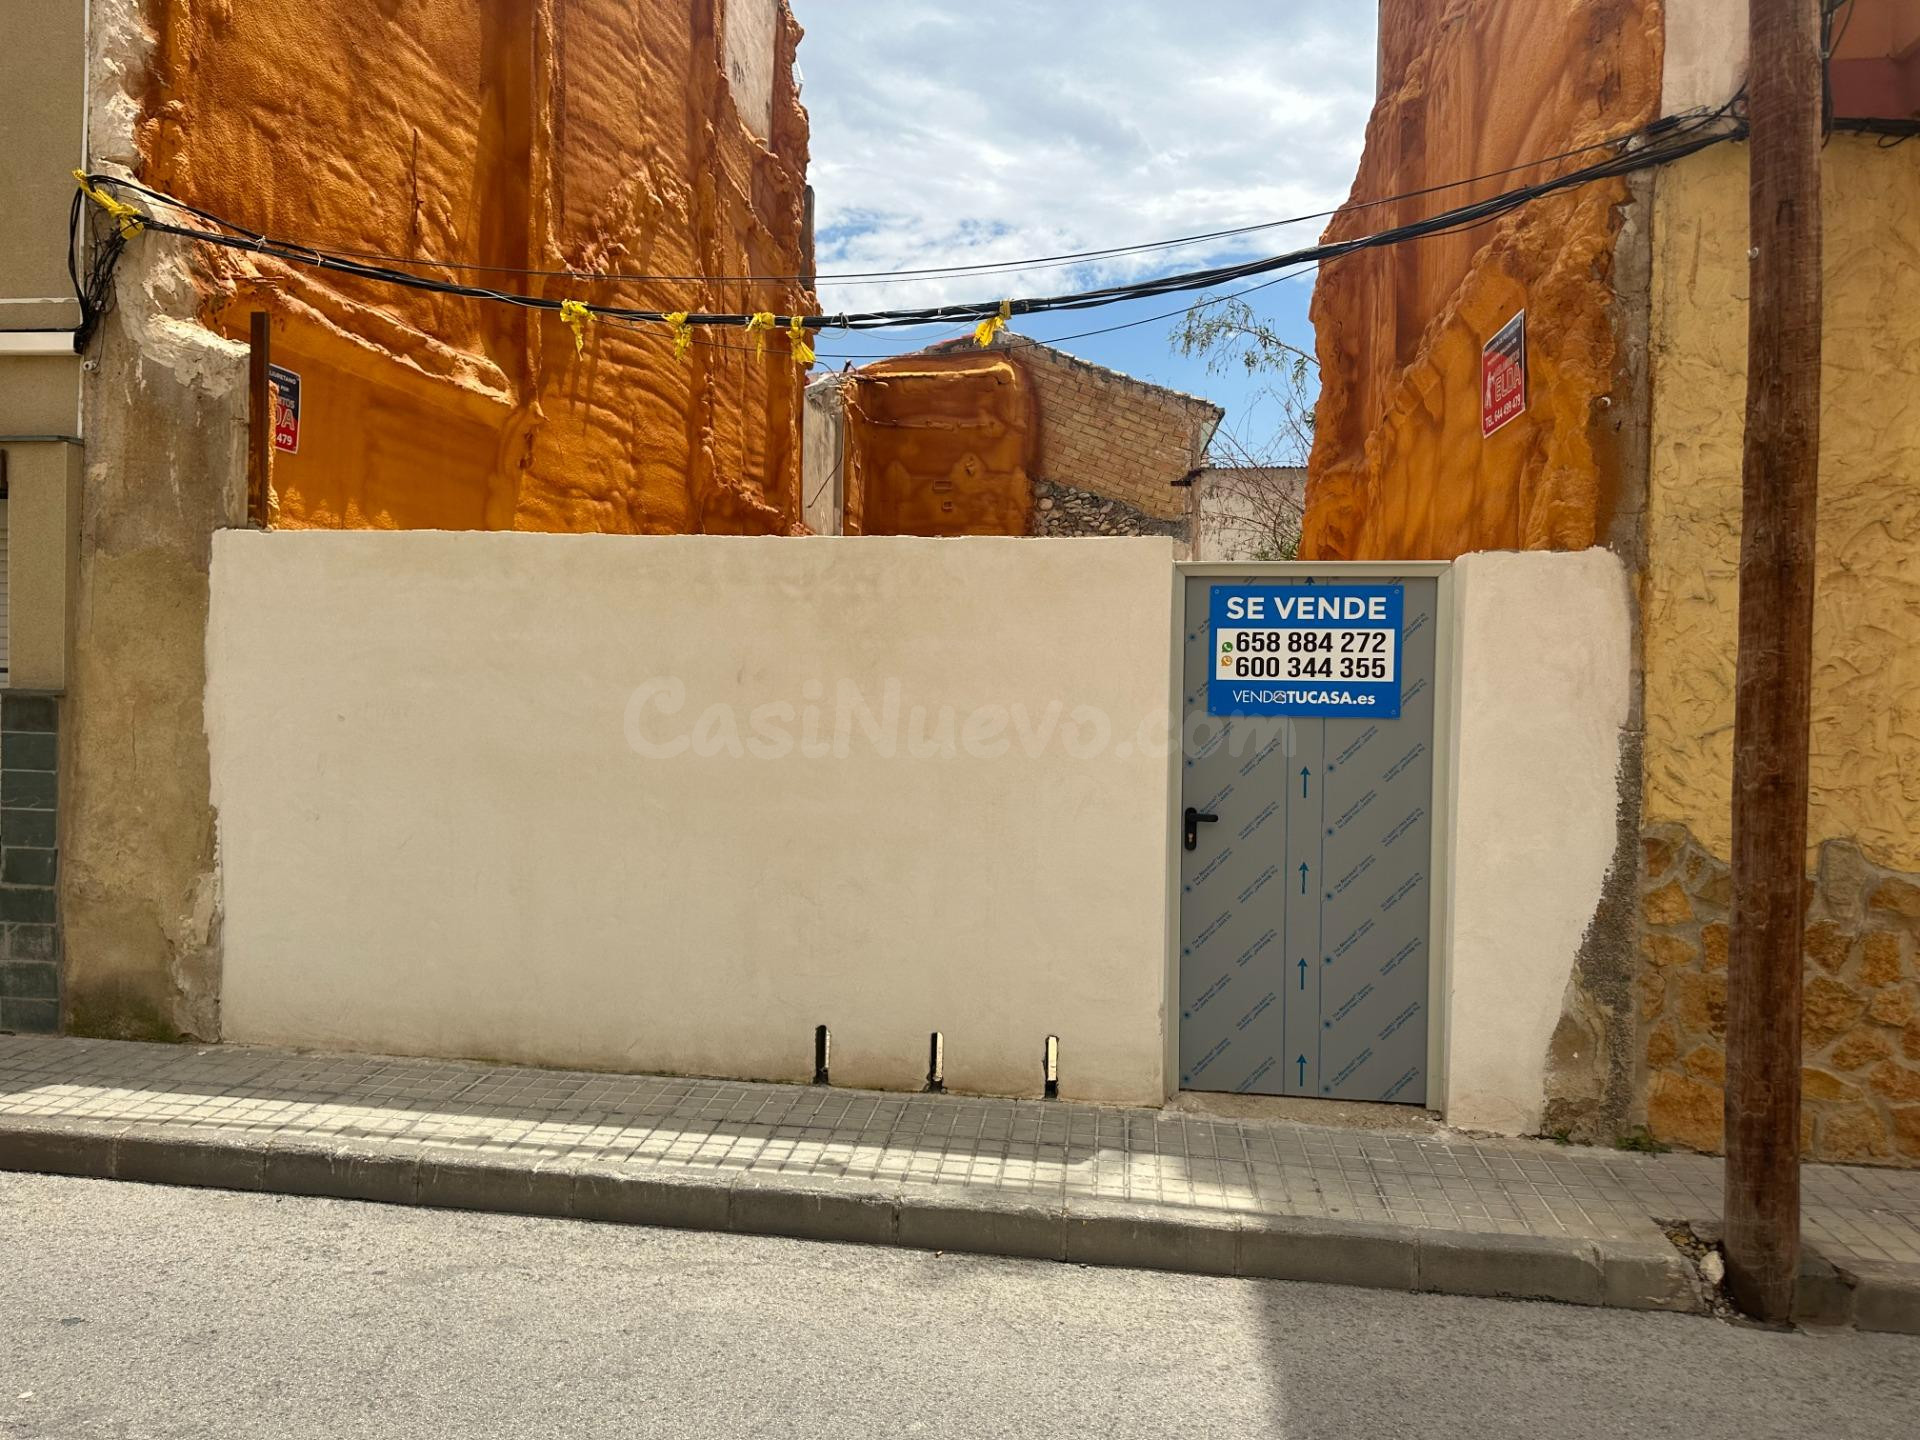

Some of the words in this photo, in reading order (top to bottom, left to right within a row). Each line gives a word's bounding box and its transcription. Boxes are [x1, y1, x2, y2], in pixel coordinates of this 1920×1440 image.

[1495, 362, 1521, 402] ELDA
[276, 432, 292, 445] 479
[1226, 596, 1265, 620] SE
[1273, 596, 1387, 620] VENDE
[1236, 631, 1281, 653] 658
[1287, 632, 1333, 653] 884
[1340, 632, 1387, 653] 272
[1235, 657, 1280, 678] 600
[1287, 657, 1333, 678] 344
[1340, 657, 1386, 679] 355
